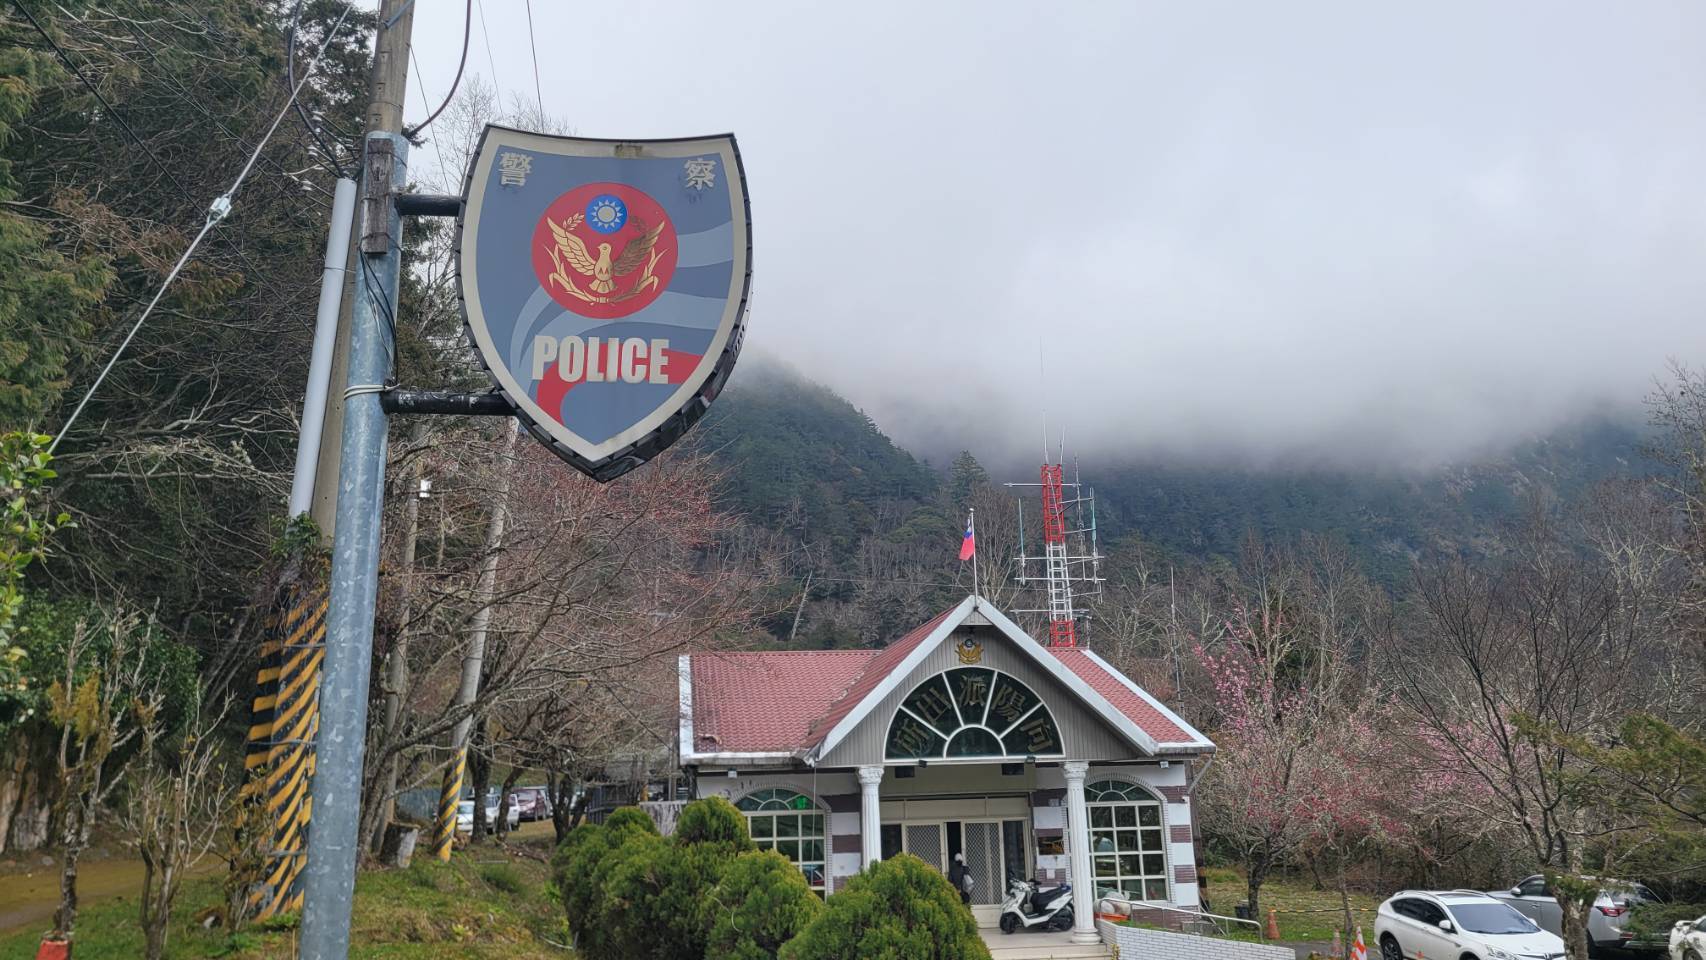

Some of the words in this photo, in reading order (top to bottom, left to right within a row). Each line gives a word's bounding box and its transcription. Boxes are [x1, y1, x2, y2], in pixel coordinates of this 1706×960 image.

[499, 151, 533, 187] 警
[684, 157, 717, 190] 察
[531, 335, 670, 384] POLICE
